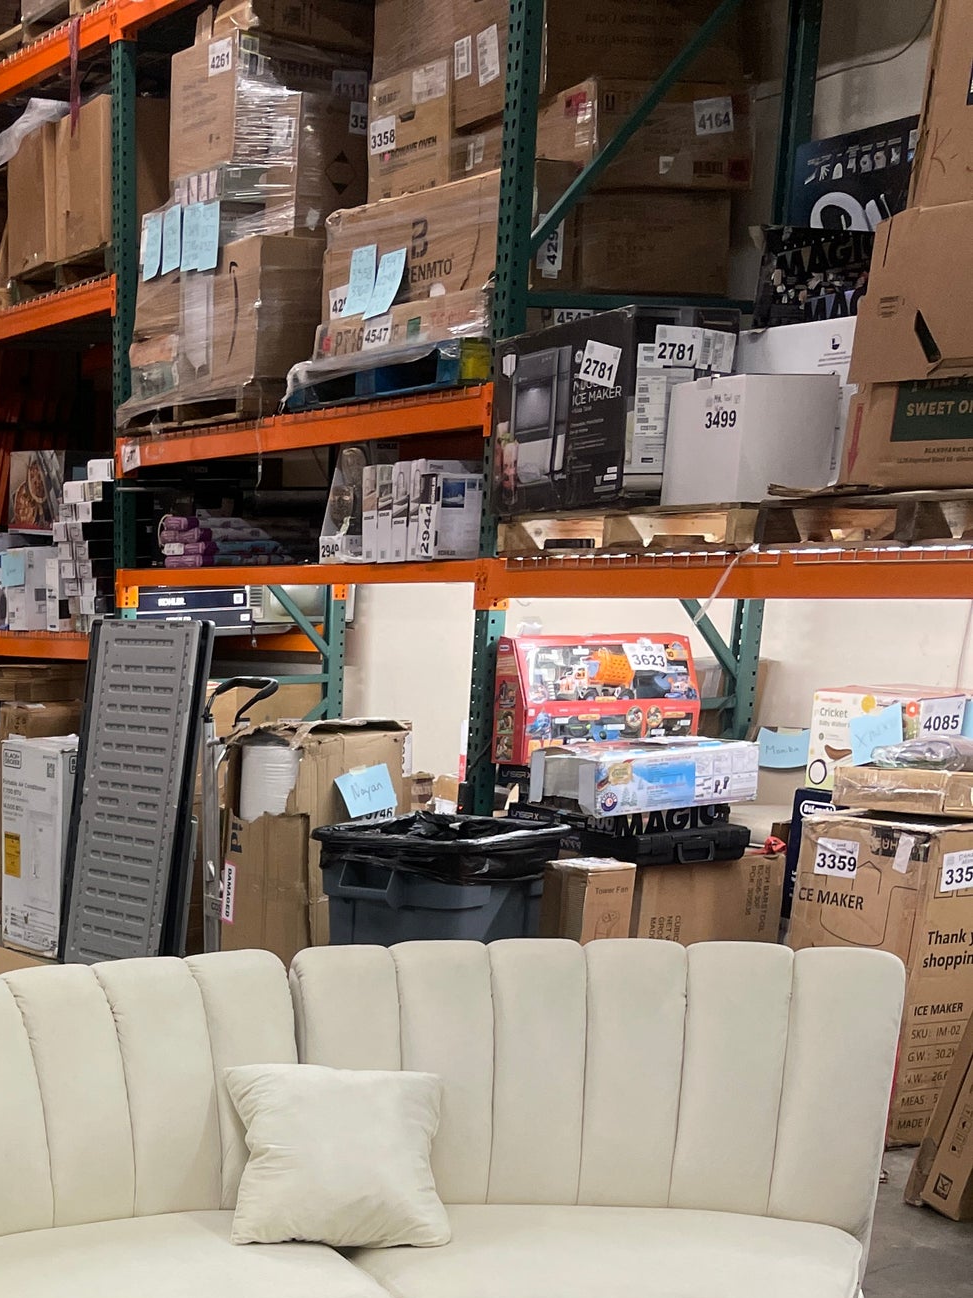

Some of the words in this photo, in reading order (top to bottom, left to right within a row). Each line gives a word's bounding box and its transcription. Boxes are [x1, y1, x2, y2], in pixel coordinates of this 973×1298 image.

[697, 111, 731, 131] 4164
[370, 128, 396, 149] 3358
[364, 328, 389, 344] 4547
[657, 342, 695, 362] 2781
[583, 357, 615, 383] 2781
[572, 392, 587, 406] ICE
[588, 385, 623, 403] MAKER
[906, 401, 956, 417] SWEET
[704, 410, 737, 429] 3499
[420, 504, 434, 556] 2944
[632, 654, 666, 673] 3623
[819, 706, 849, 718] Cricket
[923, 714, 960, 732] 4085
[816, 852, 857, 872] 3359
[944, 865, 973, 886] 335
[224, 867, 233, 918] DAMAGED
[798, 886, 815, 903] CE
[816, 888, 865, 911] MAKER
[928, 929, 967, 946] Thank
[922, 951, 973, 971] shoppin
[913, 1004, 929, 1017] ICE
[930, 1002, 964, 1016] MAKER
[936, 1025, 961, 1038] IM-02
[898, 1120, 921, 1134] MADE
